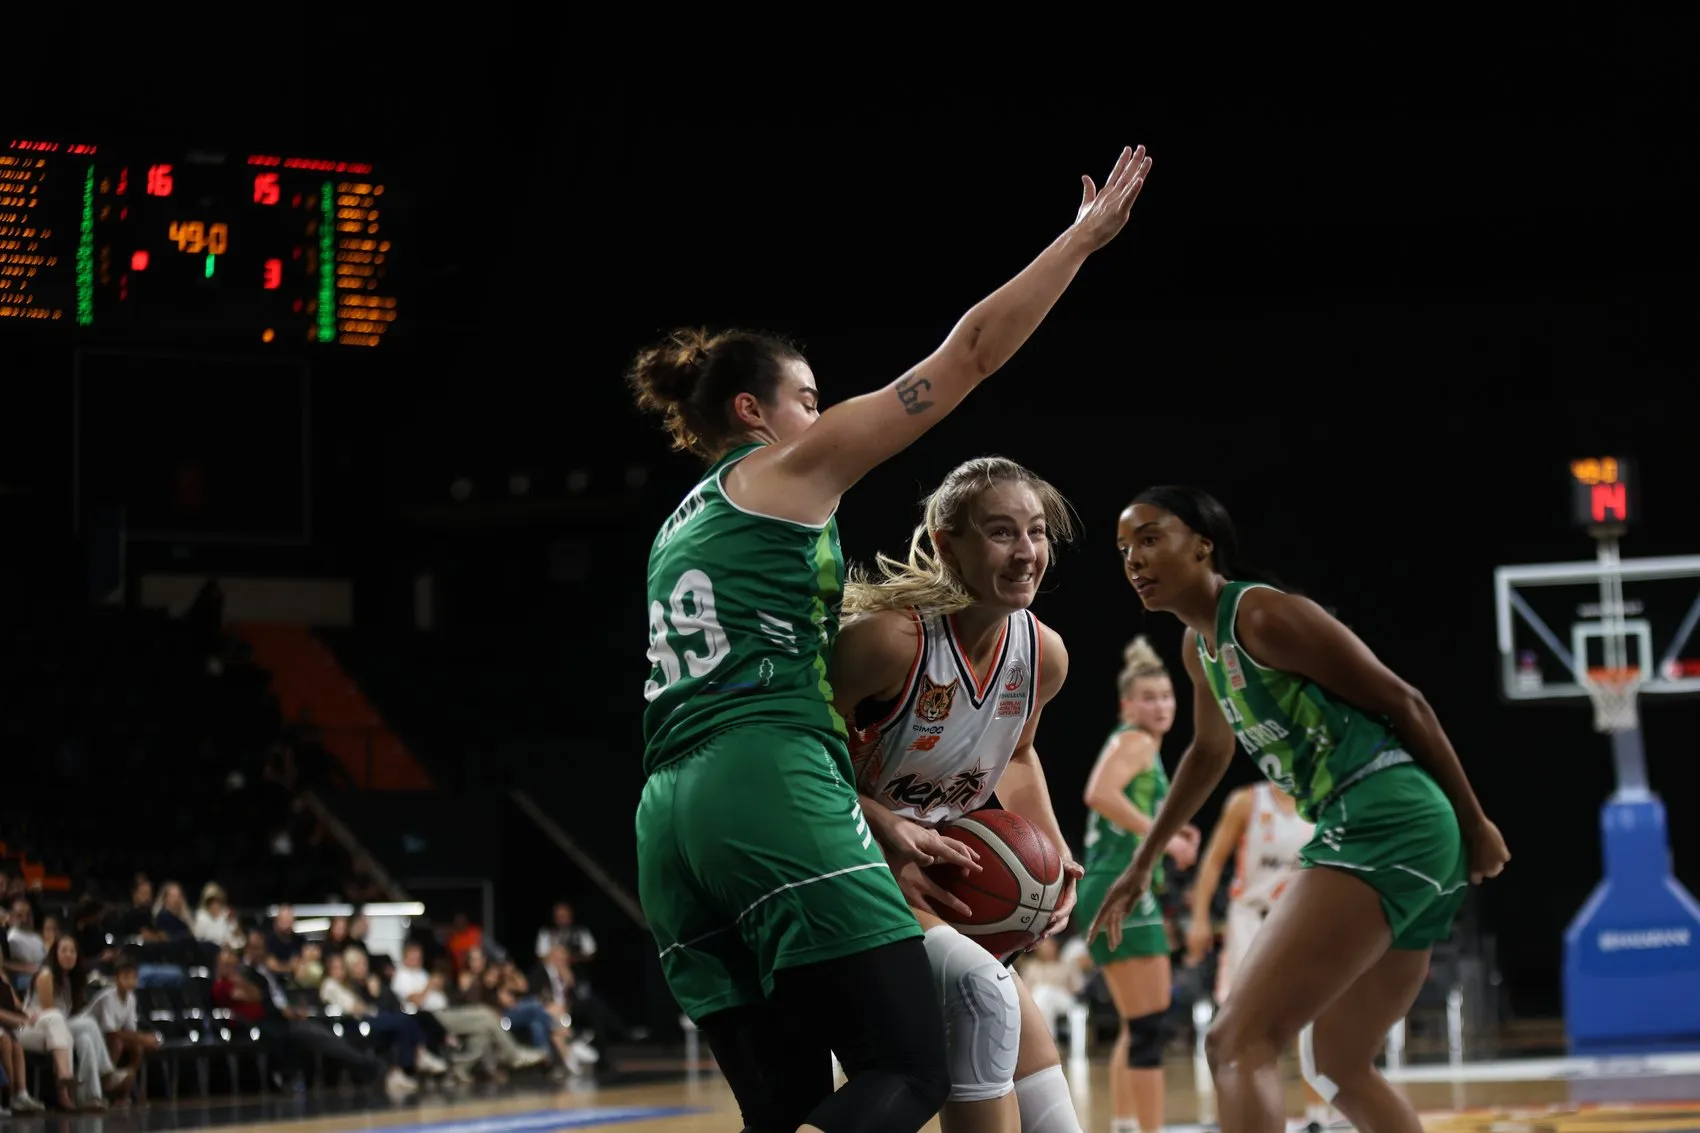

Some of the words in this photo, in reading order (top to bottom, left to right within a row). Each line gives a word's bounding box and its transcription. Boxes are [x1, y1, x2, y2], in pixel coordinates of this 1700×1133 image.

[147, 164, 173, 197] 16
[253, 172, 280, 205] 15
[169, 221, 228, 254] 49.0
[1030, 892, 1040, 901] B
